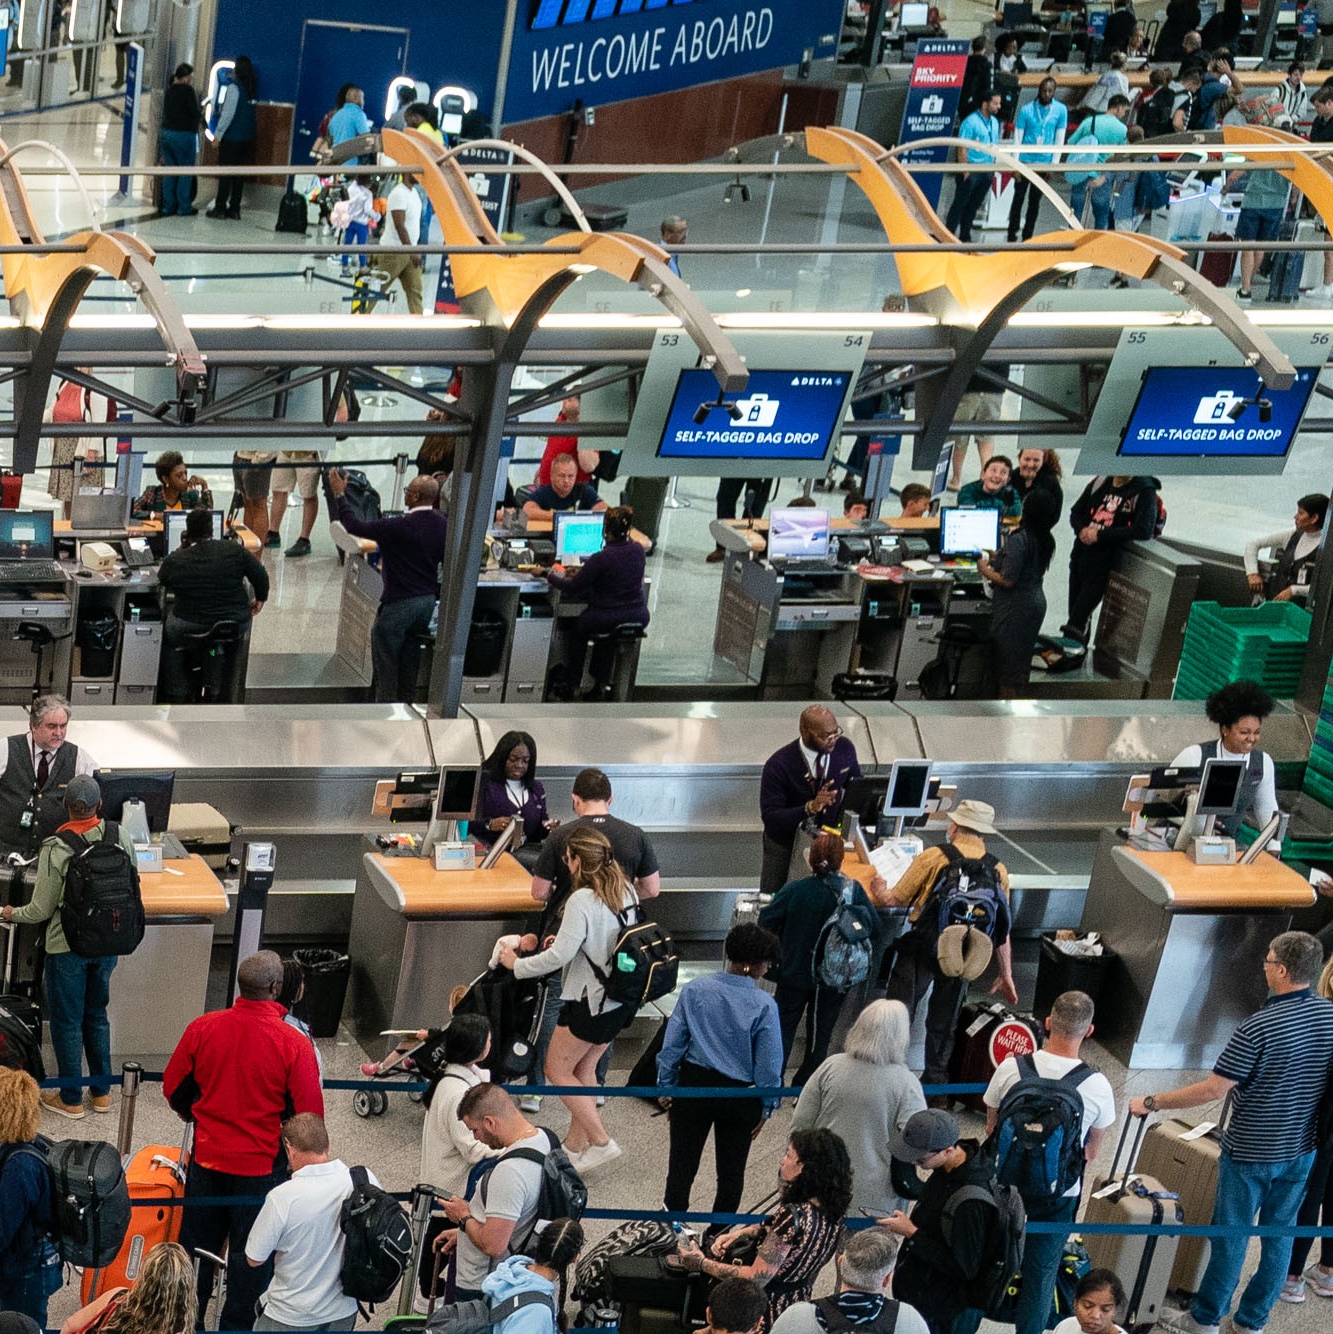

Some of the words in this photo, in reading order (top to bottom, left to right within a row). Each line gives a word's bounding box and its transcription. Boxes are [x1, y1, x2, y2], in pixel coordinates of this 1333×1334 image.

[532, 27, 666, 93] WELCOME
[670, 8, 773, 67] ABOARD
[931, 44, 956, 52] DELTA
[916, 67, 935, 75] SKY
[914, 73, 958, 83] PRIORITY
[907, 116, 951, 125] SELF-TAGGED
[911, 123, 927, 132] BAG
[927, 123, 944, 131] DROP
[472, 147, 497, 159] DELTA
[661, 334, 679, 346] 53
[844, 336, 863, 347] 54
[1127, 332, 1147, 344] 55
[1310, 333, 1329, 345] 56
[801, 377, 833, 385] DELTA
[675, 431, 755, 443] SELF-TAGGED
[757, 432, 782, 444] BAG
[784, 432, 819, 444] DROP
[1137, 428, 1216, 440] SELF-TAGGED
[1218, 428, 1244, 440] BAG
[1246, 428, 1282, 440] DROP
[997, 1033, 1015, 1050] WAIT
[1005, 1028, 1029, 1047] PLEASE
